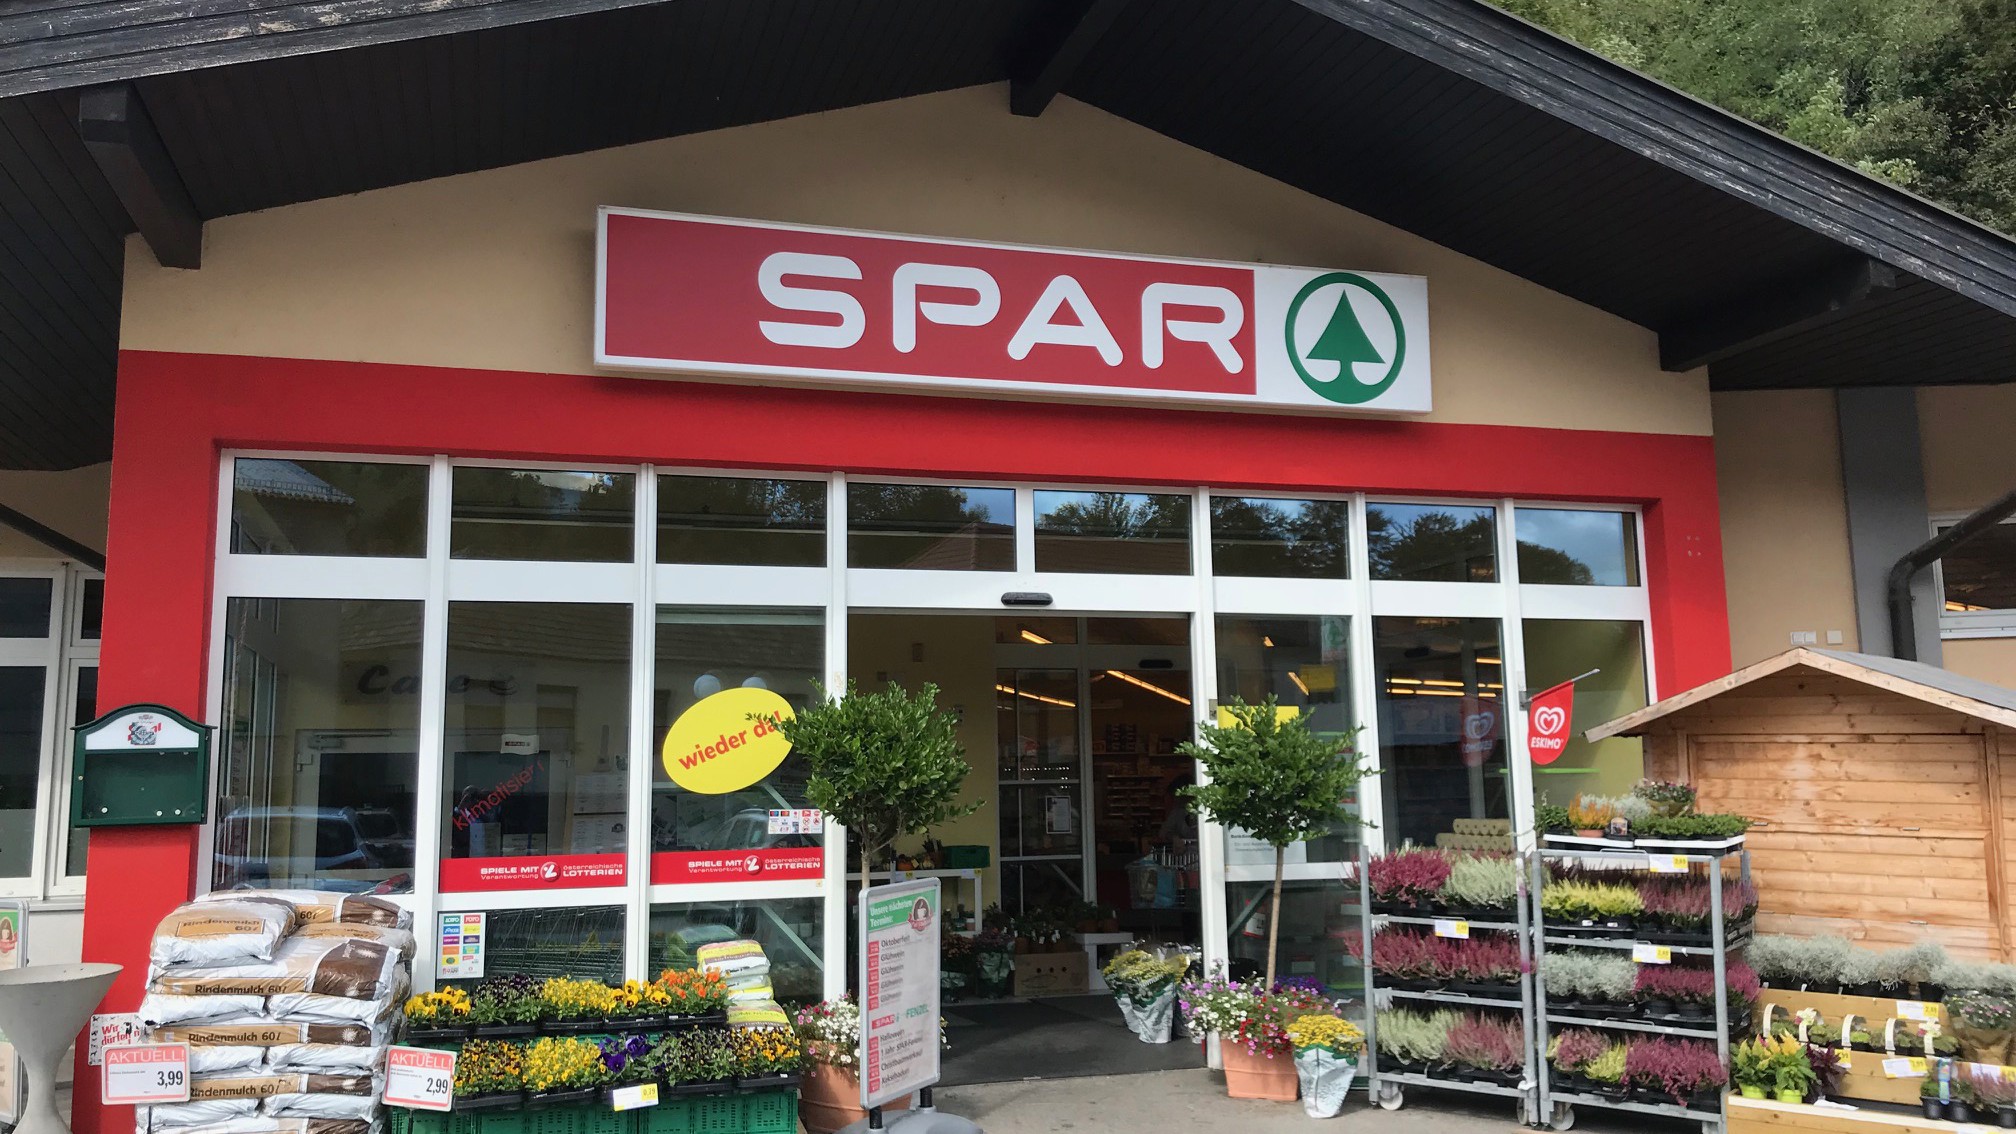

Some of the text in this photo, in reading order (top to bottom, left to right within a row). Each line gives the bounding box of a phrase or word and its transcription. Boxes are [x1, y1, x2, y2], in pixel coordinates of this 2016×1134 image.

[758, 251, 1245, 374] SPAR
[1530, 736, 1561, 750] ESKIMO
[678, 729, 748, 770] wieder
[688, 859, 743, 869] SPIELE MIT
[764, 862, 821, 871] LOTTERIEN
[480, 865, 539, 875] SPIELE MIT
[563, 868, 623, 877] LOTTERIEN
[688, 866, 743, 874] Verantwortung
[480, 873, 539, 881] Verantwortung
[182, 919, 260, 928] Rindenmulch
[194, 984, 265, 995] Rindenmulch
[101, 1024, 120, 1036] Wir
[188, 1032, 258, 1043] Rindenmulch
[108, 1049, 185, 1064] AKTUELL!
[390, 1052, 452, 1070] AKTUELL!
[157, 1070, 184, 1089] 3,99
[425, 1077, 449, 1096] 2,99
